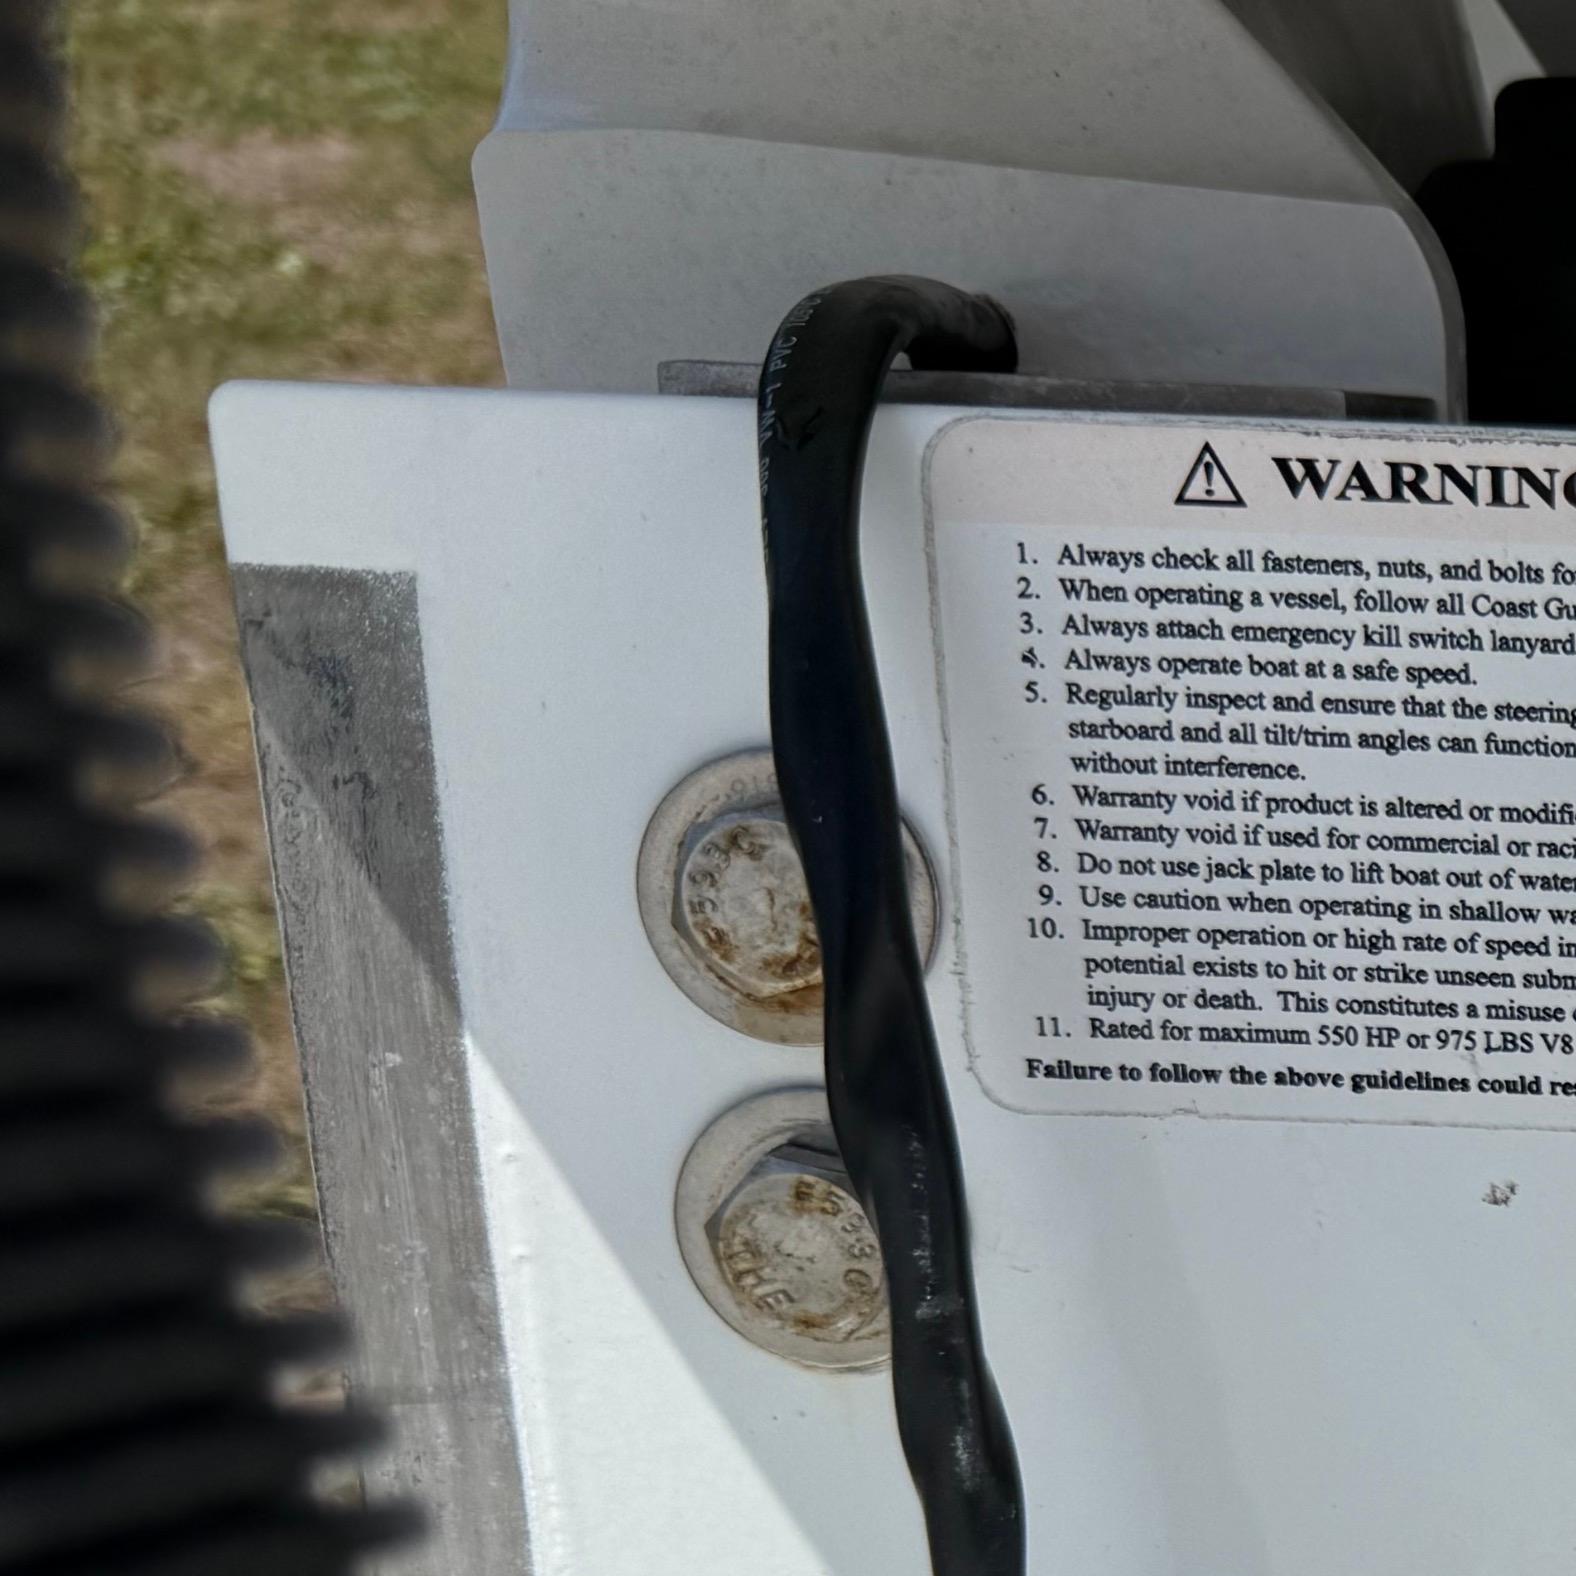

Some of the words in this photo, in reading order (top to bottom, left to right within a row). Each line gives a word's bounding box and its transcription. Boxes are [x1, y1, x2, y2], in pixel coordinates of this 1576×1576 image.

[1016, 540, 1039, 566] 1.
[1057, 542, 1146, 575] Always
[1150, 545, 1221, 572] check
[1225, 547, 1255, 574] all
[1260, 548, 1371, 582] fasteners,
[1376, 557, 1434, 584] nuts,
[1439, 558, 1484, 583] and
[1486, 557, 1545, 586] bolts
[1016, 574, 1041, 601] 2.
[1057, 576, 1129, 604] When
[1133, 582, 1245, 614] operating
[1249, 589, 1265, 609] a
[1268, 586, 1348, 616] vessel,
[1353, 586, 1430, 615] follow
[1435, 591, 1466, 617] all
[1470, 592, 1539, 620] Coast
[1063, 647, 1152, 678] Always
[1156, 654, 1243, 681] operate
[1246, 653, 1300, 679] boat
[1304, 658, 1327, 680] at
[1331, 662, 1347, 681] a
[1351, 656, 1400, 683] safe
[1404, 661, 1478, 691] speed.
[1024, 679, 1048, 704] 5.
[1064, 680, 1179, 715] Regularly
[1184, 684, 1267, 717] inspect
[1271, 689, 1316, 714] and
[1320, 695, 1397, 717] ensure
[1400, 693, 1447, 719] that
[1450, 695, 1488, 721] the
[1030, 782, 1055, 807] 6.
[1071, 783, 1178, 816] Warranty
[1182, 787, 1236, 813] void
[1240, 788, 1263, 814] if
[1264, 791, 1354, 820] product
[1358, 793, 1380, 818] is
[1384, 795, 1464, 822] altered
[1467, 804, 1495, 823] or
[1033, 815, 1057, 840] 7.
[1073, 816, 1180, 850] Warranty
[1184, 821, 1238, 846] void
[1242, 822, 1265, 847] if
[1266, 825, 1321, 849] used
[1325, 825, 1361, 851] for
[1365, 832, 1501, 857] commercial
[1505, 839, 1533, 858] or
[1036, 849, 1060, 874] 8.
[1076, 850, 1113, 876] Do
[1117, 856, 1157, 877] not
[1160, 859, 1201, 879] use
[1203, 855, 1255, 885] jack
[1258, 857, 1316, 887] plate
[1320, 862, 1345, 884] to
[1349, 860, 1385, 885] lift
[1388, 862, 1441, 887] boat
[1445, 869, 1484, 890] out
[1488, 866, 1517, 891] of
[1037, 882, 1062, 907] 9.
[1078, 884, 1127, 909] Use
[1132, 887, 1222, 913] caution
[1225, 890, 1293, 915] when
[1298, 894, 1413, 925] operating
[1417, 896, 1444, 921] in
[1448, 898, 1542, 925] shallow
[1027, 915, 1065, 940] 10.
[1080, 917, 1192, 949] Improper
[1196, 923, 1308, 951] operation
[1312, 930, 1339, 950] or
[1343, 926, 1397, 957] high
[1401, 932, 1448, 953] rate
[1452, 931, 1482, 955] of
[1484, 934, 1552, 962] speed
[1035, 1015, 1072, 1039] 11.
[1088, 1016, 1155, 1041] Rated
[1159, 1018, 1194, 1042] for
[1197, 1021, 1312, 1047] maximum
[1317, 1023, 1359, 1048] 550
[1364, 1025, 1401, 1050] HP
[1405, 1032, 1431, 1051] or
[1435, 1027, 1477, 1057] 975
[1483, 1029, 1535, 1056] LBS
[1539, 1031, 1575, 1056] V8
[1024, 1057, 1113, 1083] Failure
[1117, 1062, 1143, 1083] to
[1148, 1060, 1223, 1085] follow
[1228, 1063, 1268, 1087] the
[1273, 1065, 1345, 1090] above
[1349, 1068, 1472, 1096] guidelines
[1476, 1073, 1544, 1097] could
